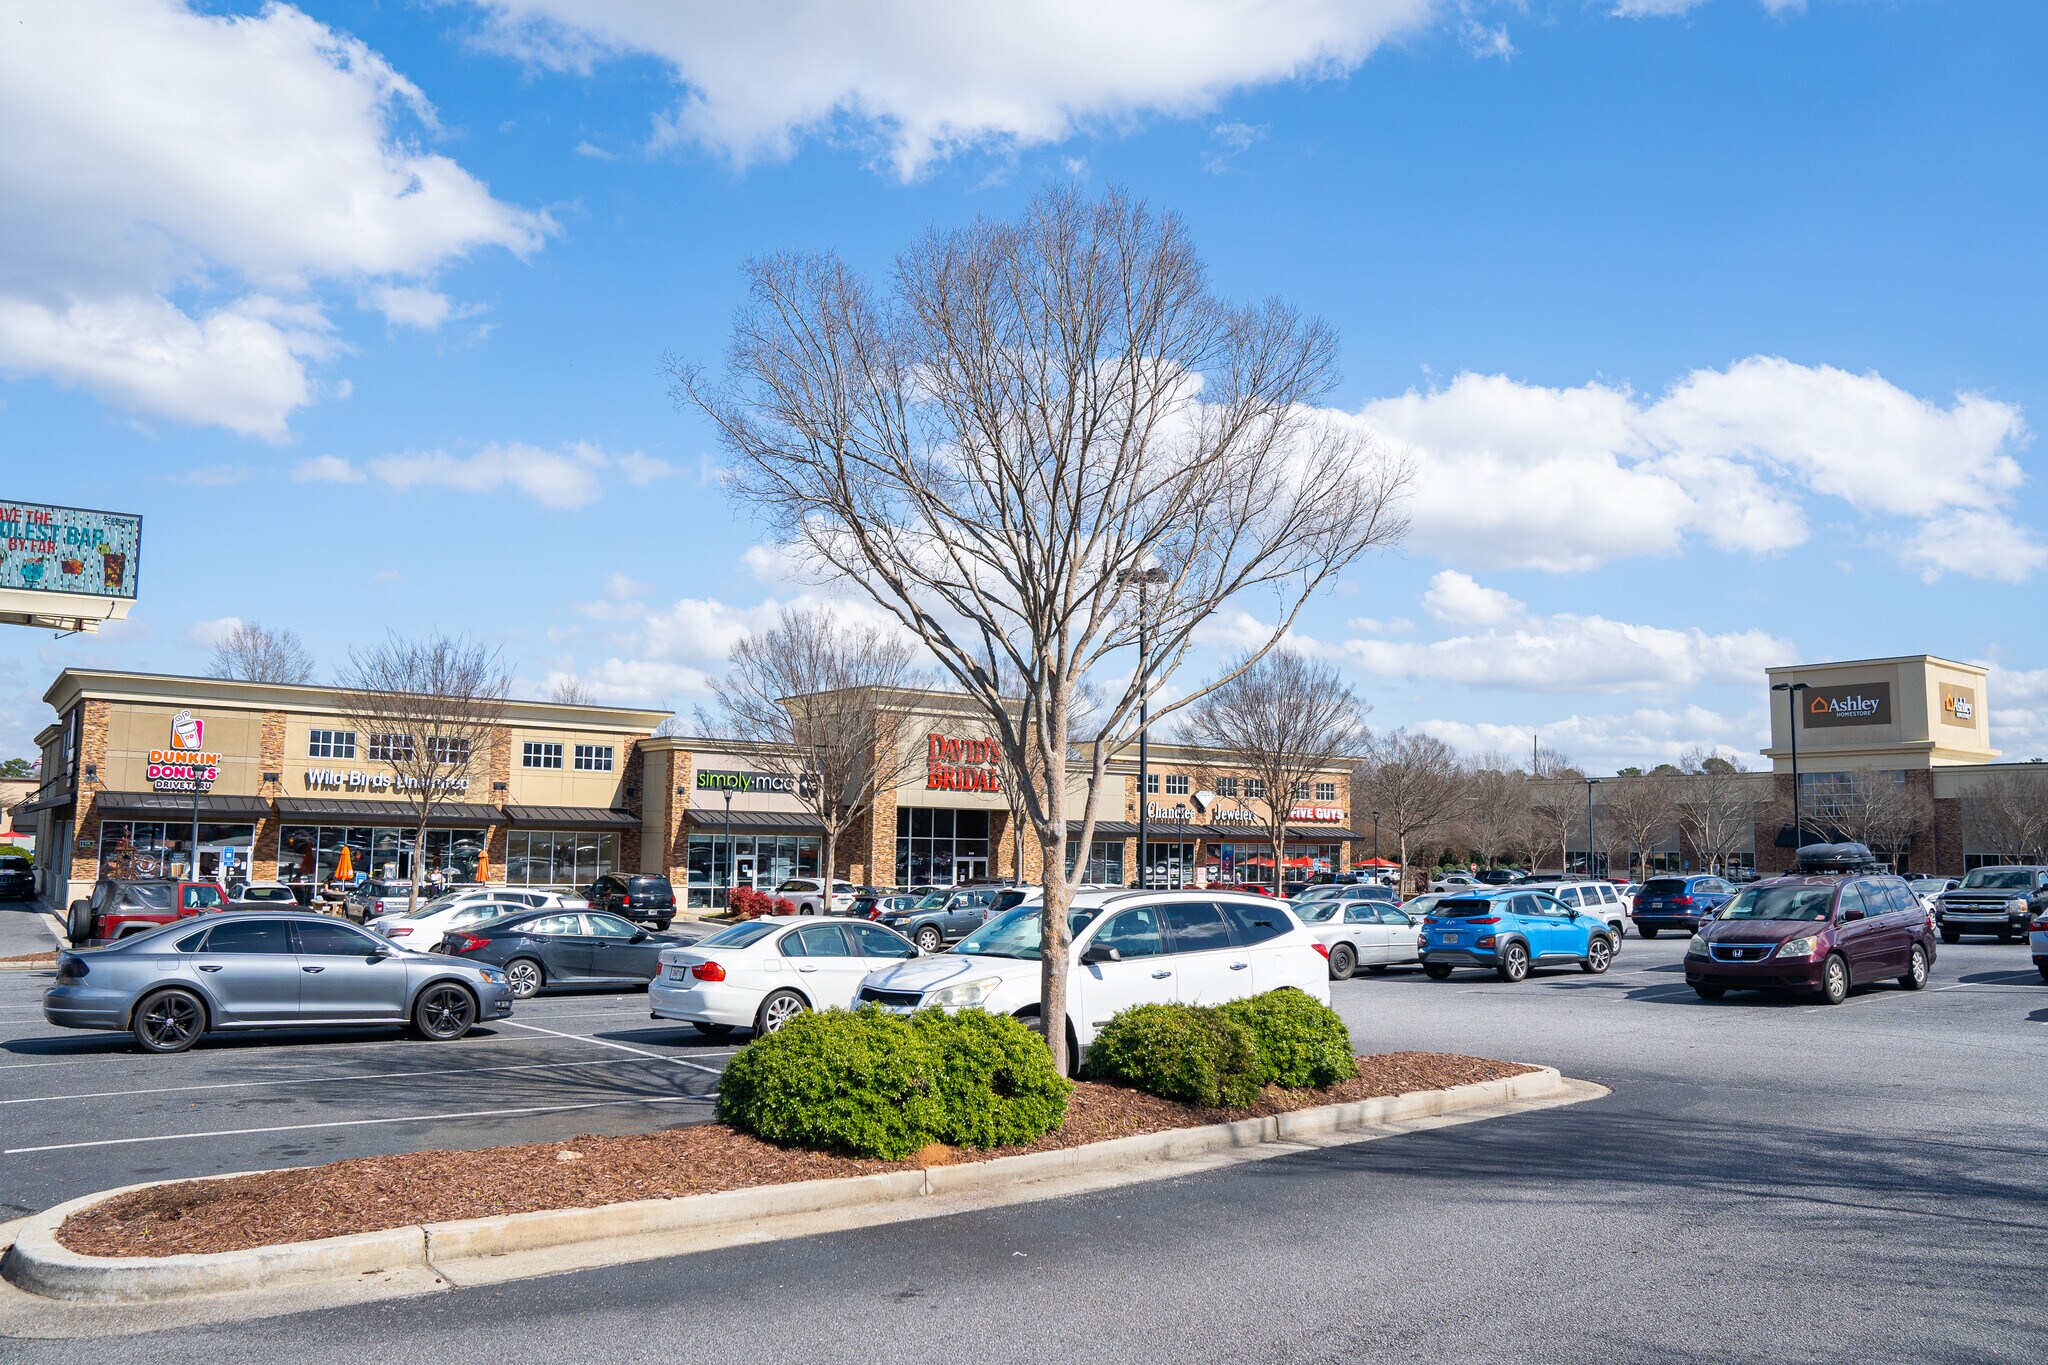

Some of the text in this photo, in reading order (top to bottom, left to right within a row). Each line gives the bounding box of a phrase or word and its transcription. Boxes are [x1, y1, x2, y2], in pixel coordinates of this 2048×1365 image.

[26, 511, 52, 526] THE
[67, 526, 104, 547] BAR
[8, 537, 55, 554] BY FAR
[1828, 695, 1879, 713] Ashley
[927, 733, 1001, 764] DAVID'S
[150, 750, 221, 765] DUNKIN'
[308, 768, 469, 790] Wild Birds Unimited
[926, 761, 1002, 791] BRIDAL
[1215, 804, 1257, 821] Jewelers
[1290, 807, 1344, 820] FIVE GUYS
